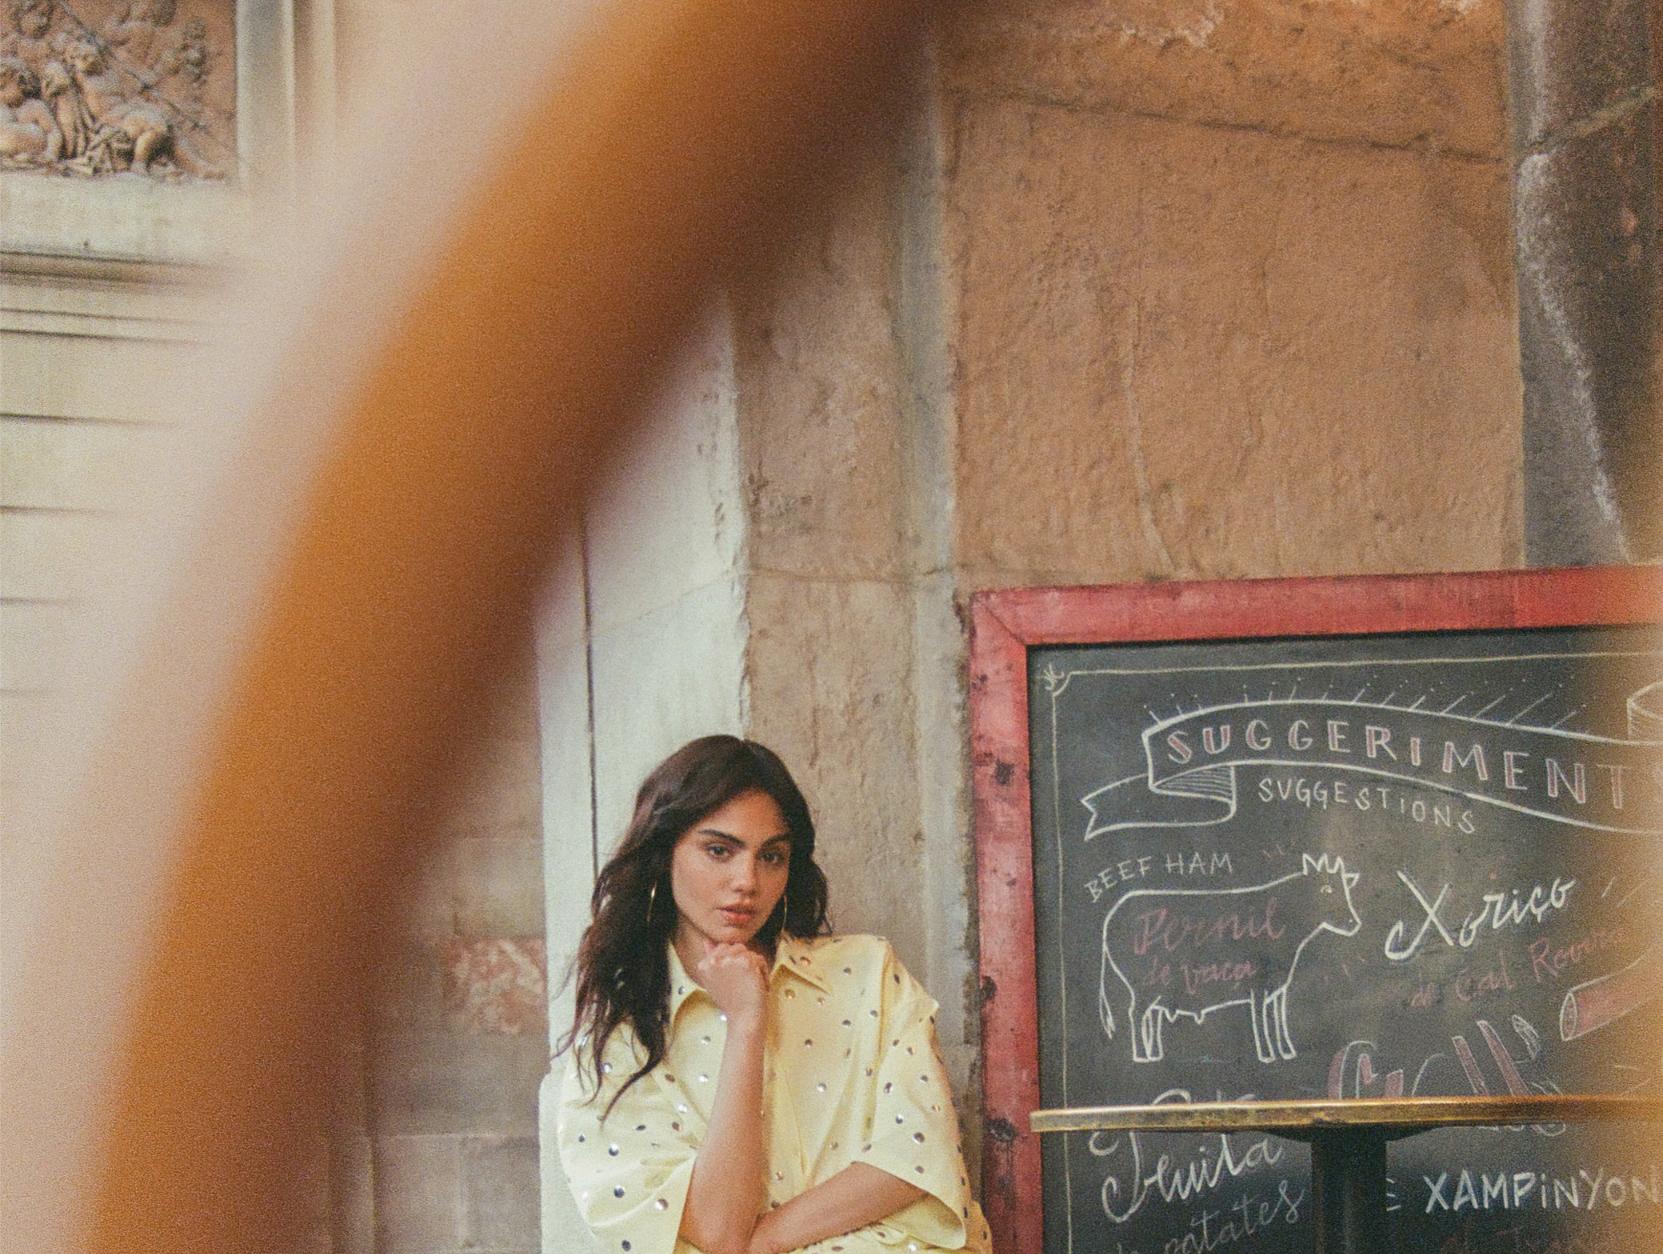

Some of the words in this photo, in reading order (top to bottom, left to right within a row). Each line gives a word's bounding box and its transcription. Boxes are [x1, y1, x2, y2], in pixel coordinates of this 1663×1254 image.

[1083, 855, 1152, 903] BEEF
[1165, 851, 1233, 876] HAM
[1133, 896, 1286, 955] Pernil
[1384, 868, 1576, 960] Xoriço
